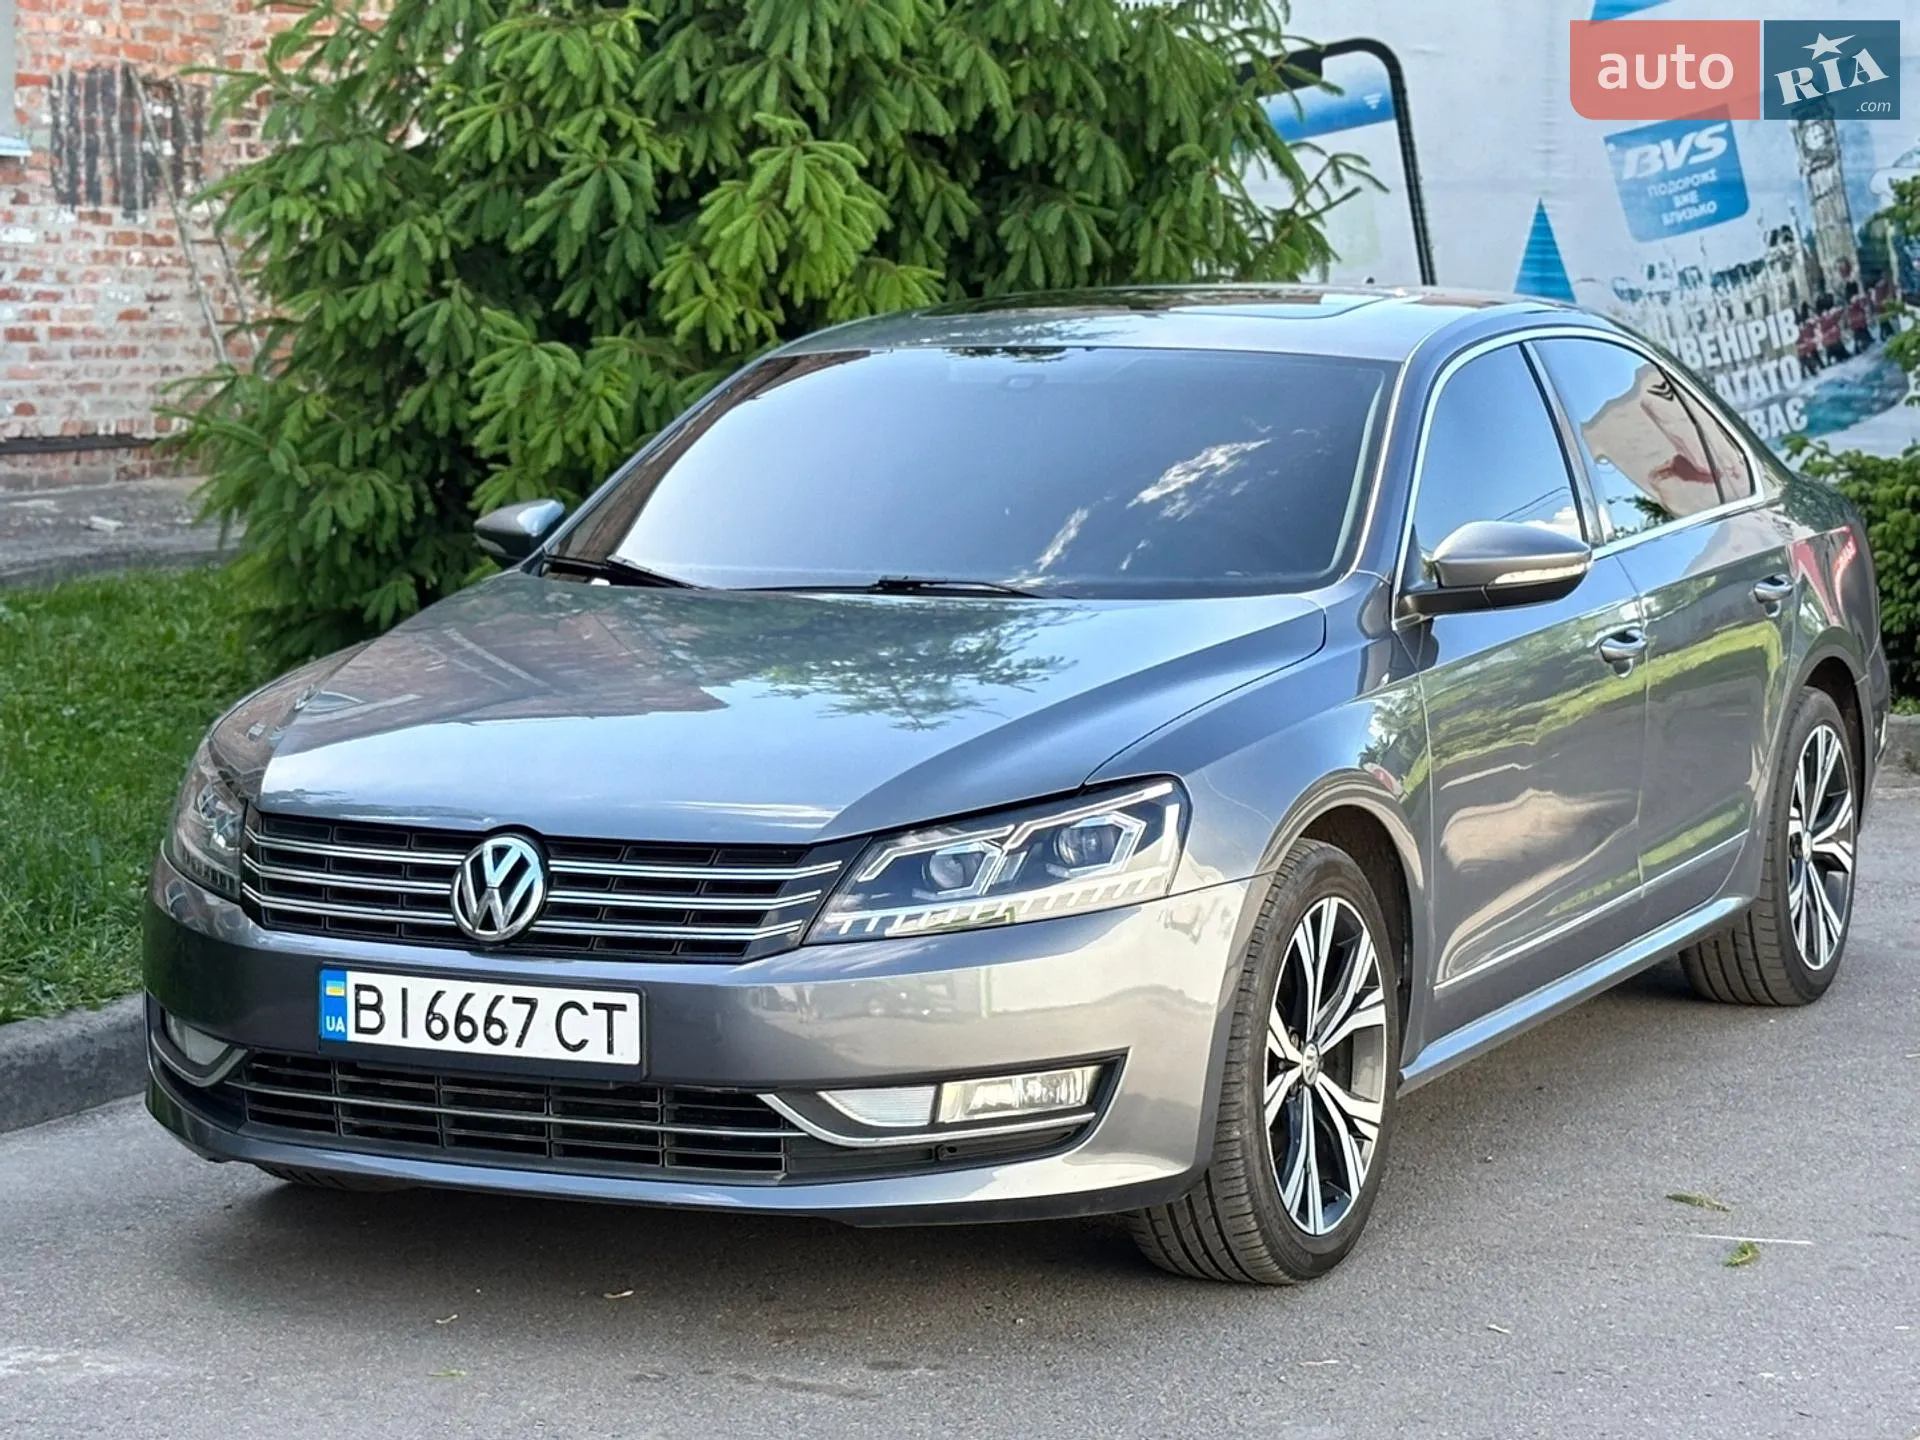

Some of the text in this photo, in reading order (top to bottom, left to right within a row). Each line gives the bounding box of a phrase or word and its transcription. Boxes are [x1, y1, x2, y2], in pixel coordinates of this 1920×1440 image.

[1623, 122, 1728, 180] BVS
[1713, 355, 1801, 405] АГАТО
[1742, 397, 1808, 441] ВАЄ
[325, 1015, 346, 1033] UA
